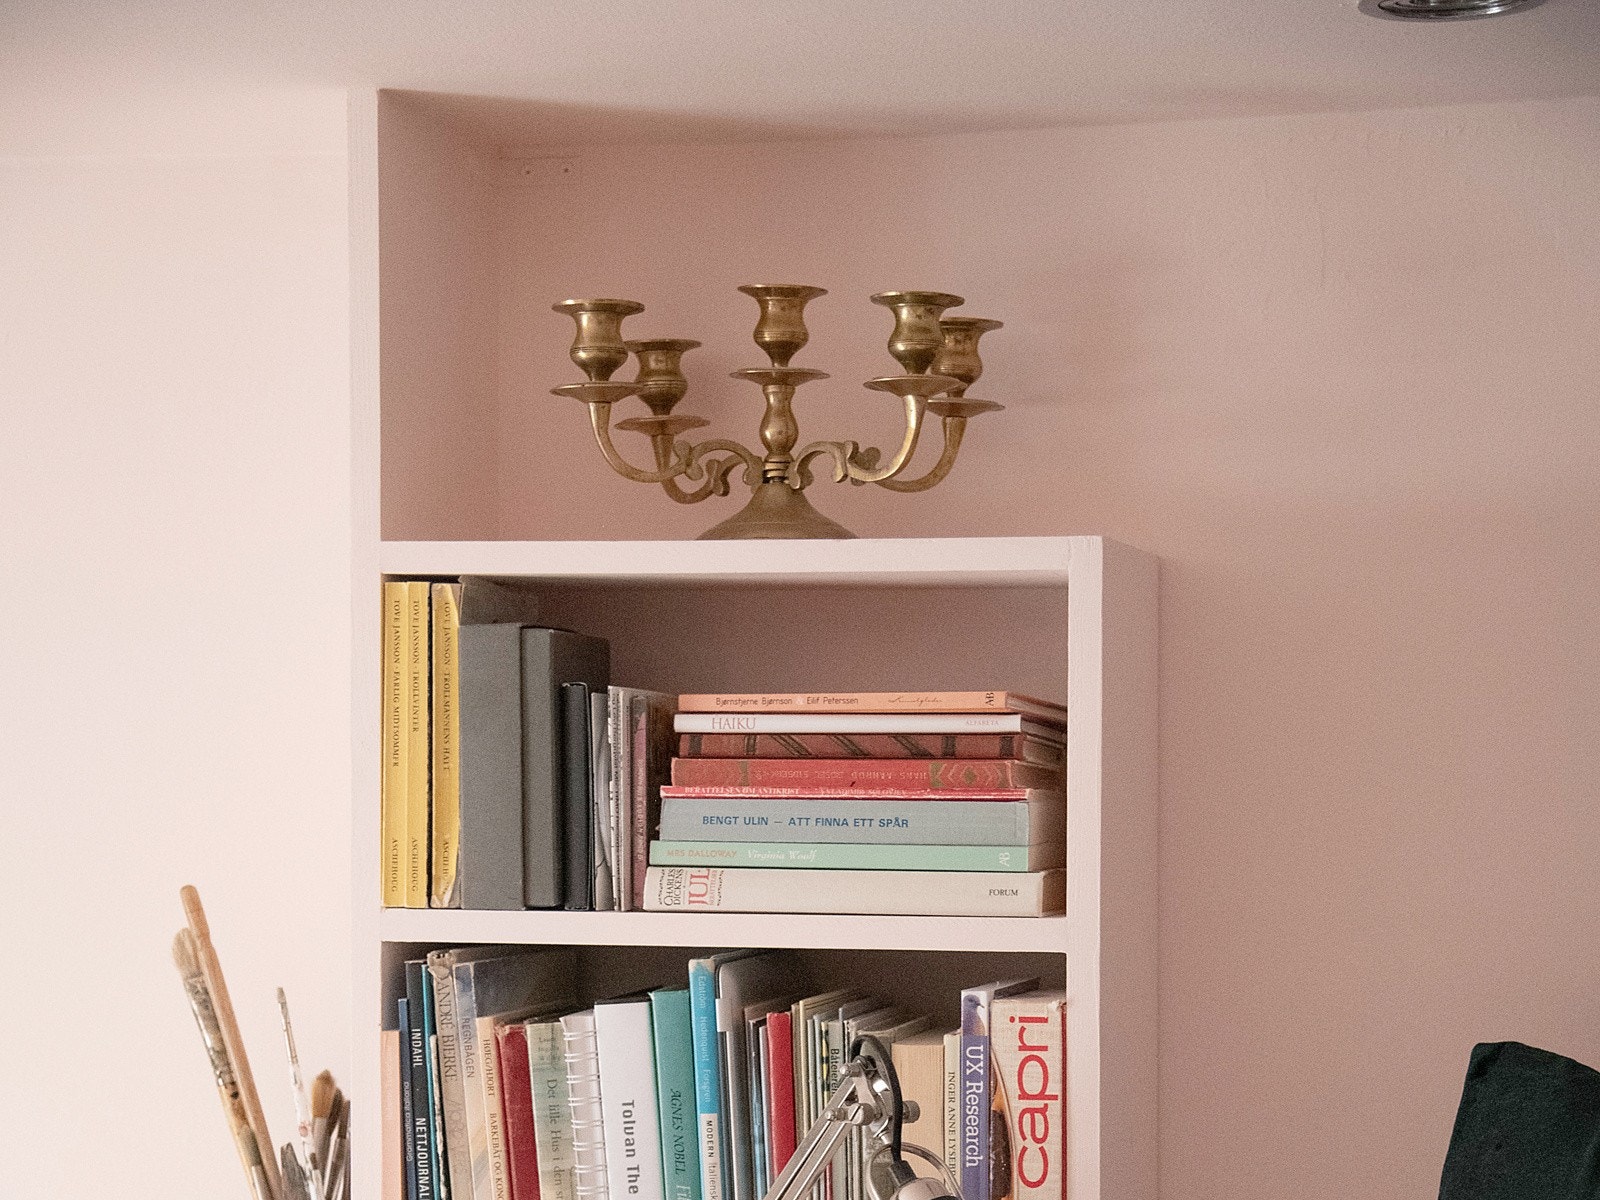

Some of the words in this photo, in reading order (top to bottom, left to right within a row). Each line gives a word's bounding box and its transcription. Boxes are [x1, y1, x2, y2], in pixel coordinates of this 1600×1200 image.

[393, 600, 401, 620] TOVE
[412, 600, 420, 620] TOVE
[392, 625, 401, 664] JANSSON
[411, 625, 420, 664] JANSSON
[442, 627, 451, 666] JANSSON
[392, 671, 401, 703] FARLIG
[412, 671, 420, 733] TROLLVINTER
[716, 697, 759, 706] Bjørnstjerne
[762, 697, 793, 705] Bjørnson
[807, 696, 820, 705] Eilif
[823, 697, 859, 705] Peterssen
[985, 692, 995, 706] AB
[392, 707, 401, 768] MIDTSOMMER
[712, 717, 756, 730] HAIKU
[758, 787, 800, 795] ANTIKRIST
[702, 815, 739, 825] BENGT
[743, 816, 769, 826] ULIN
[788, 817, 811, 826] ATT
[815, 817, 849, 827] FINNA
[853, 818, 874, 828] ETT
[878, 817, 909, 828] SPÅR
[391, 838, 399, 893] ASCHEHOUG
[411, 837, 419, 892] ASCHEHOUG
[667, 850, 686, 858] MRS
[688, 850, 738, 858] DALLOWAY
[747, 849, 786, 861] Virginia
[790, 849, 818, 861] Woolf
[663, 869, 675, 906] CHARLES
[673, 868, 684, 905] DICKENS
[437, 981, 456, 1030] ANDRÉ
[697, 976, 708, 1010] Edström
[411, 1028, 423, 1068] INDAHL
[461, 1017, 476, 1078] REGNBÅGEN
[965, 1045, 984, 1076] UX
[483, 1039, 496, 1098] HØEG/HJORT
[701, 1069, 712, 1103] Forsgren
[547, 1079, 558, 1100] Det
[947, 1071, 956, 1104] INGER
[1008, 1014, 1059, 1189] capri
[550, 1104, 561, 1124] lille
[670, 1089, 683, 1131] AGNES
[948, 1106, 956, 1136] ANNE
[965, 1080, 984, 1168] Research
[405, 1112, 413, 1162] Grammatica
[489, 1113, 503, 1159] BARKEBÅT
[550, 1130, 562, 1153] Hus
[704, 1119, 715, 1158] MODERN
[494, 1161, 502, 1175] OG
[673, 1134, 686, 1176] NOBEL
[554, 1166, 566, 1187] den
[626, 1164, 641, 1195] The
[706, 1161, 718, 1200] Italiensk
